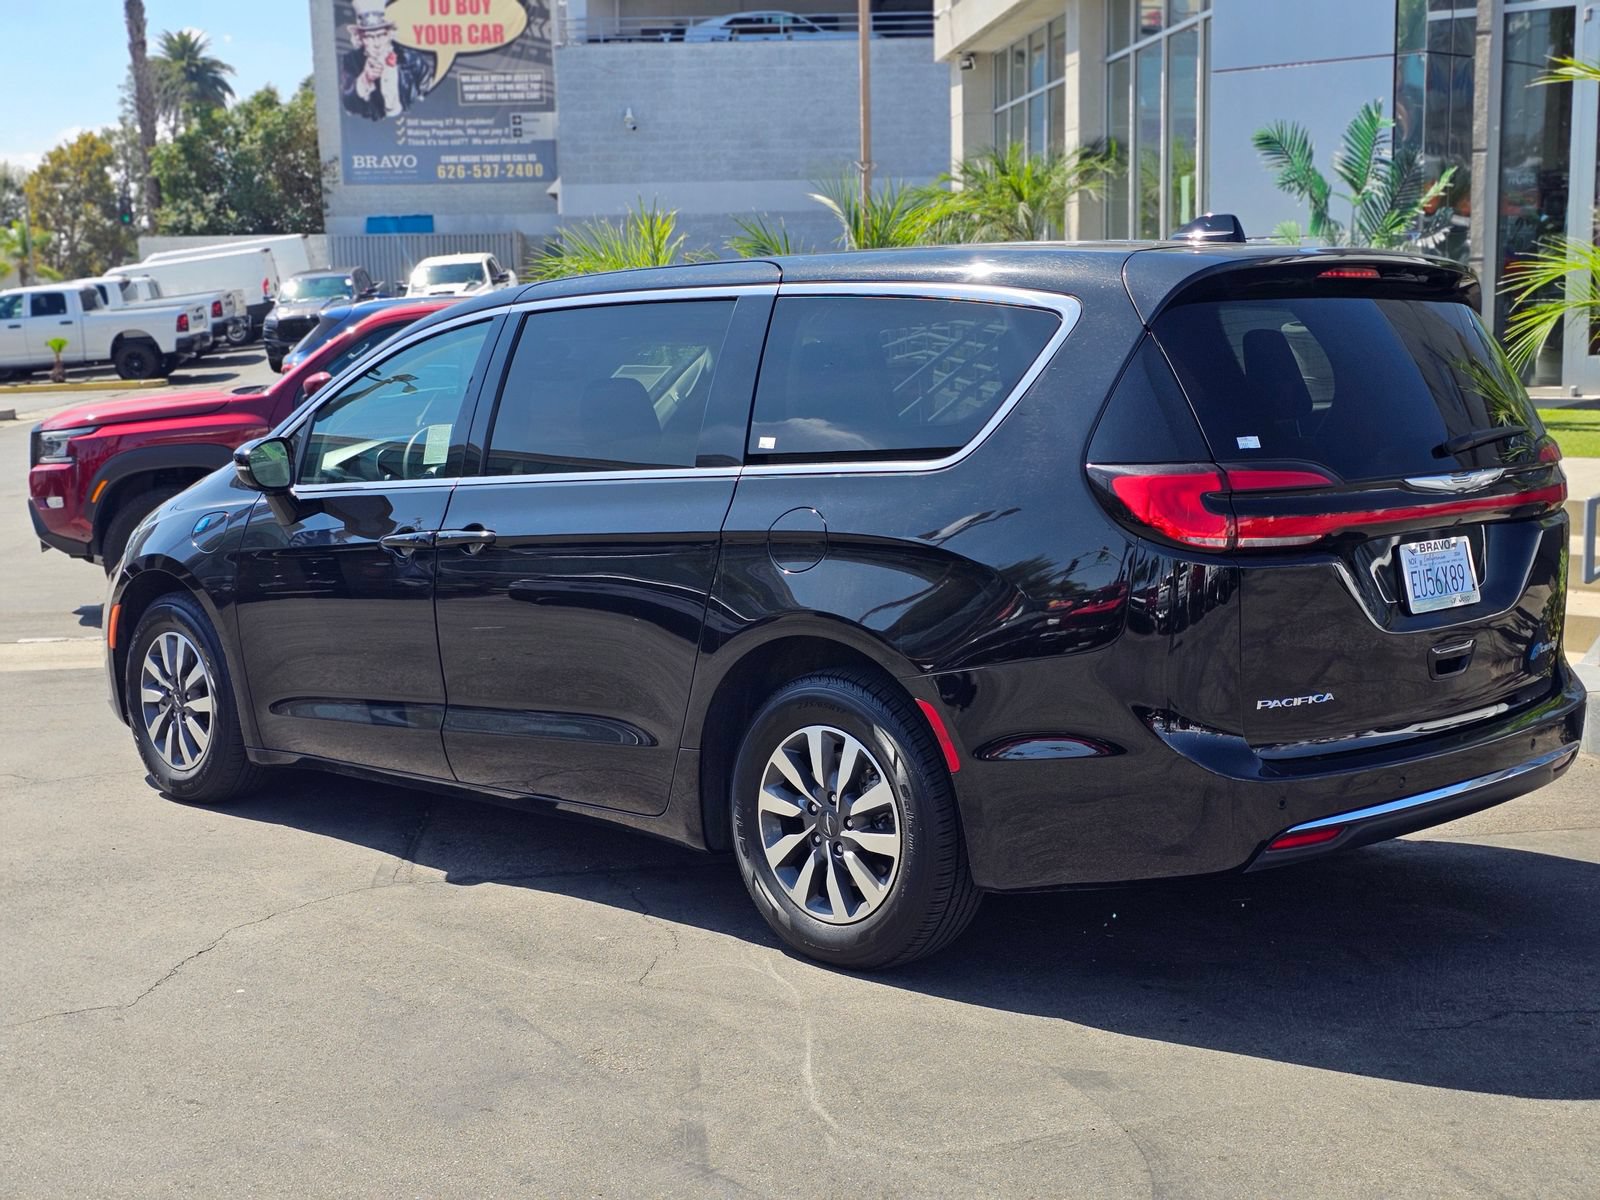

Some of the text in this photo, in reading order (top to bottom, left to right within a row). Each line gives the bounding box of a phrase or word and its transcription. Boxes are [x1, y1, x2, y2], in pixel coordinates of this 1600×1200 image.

[428, 0, 490, 16] TO BUY
[412, 23, 505, 45] YOUR CAR
[352, 154, 417, 169] BRAVO
[437, 163, 544, 179] 626-537-2400
[1419, 540, 1451, 552] BRAVO
[1411, 564, 1465, 599] EU56X89
[1257, 693, 1334, 709] PACIFICA
